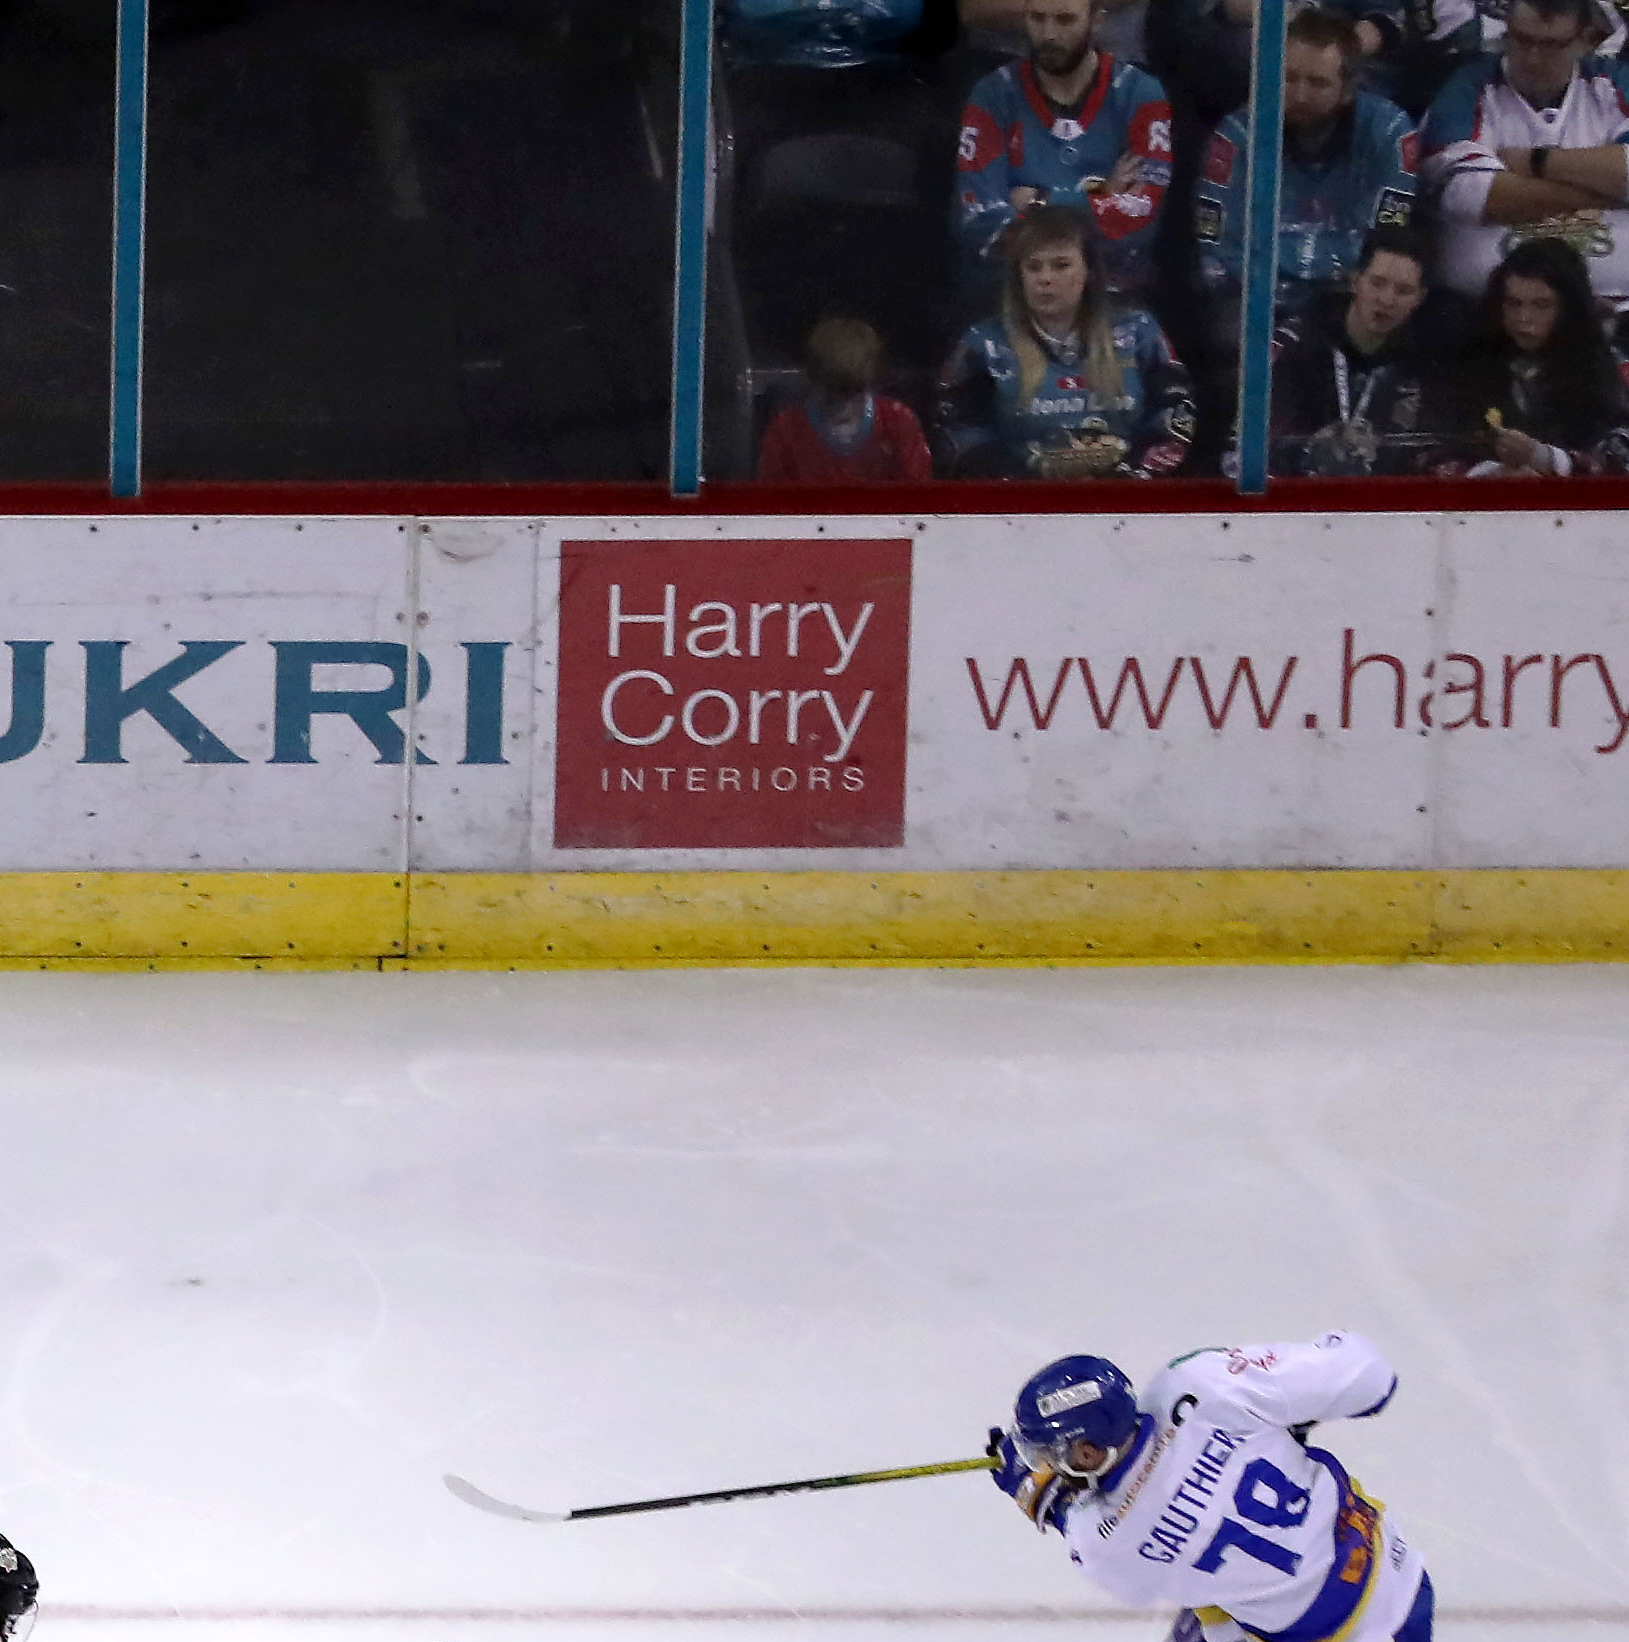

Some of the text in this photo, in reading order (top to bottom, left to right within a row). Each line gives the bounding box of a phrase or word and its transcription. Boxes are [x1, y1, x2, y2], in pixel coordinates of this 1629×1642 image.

[608, 583, 874, 676] Harry
[602, 669, 873, 762] Corry
[600, 766, 866, 793] INTERIORS
